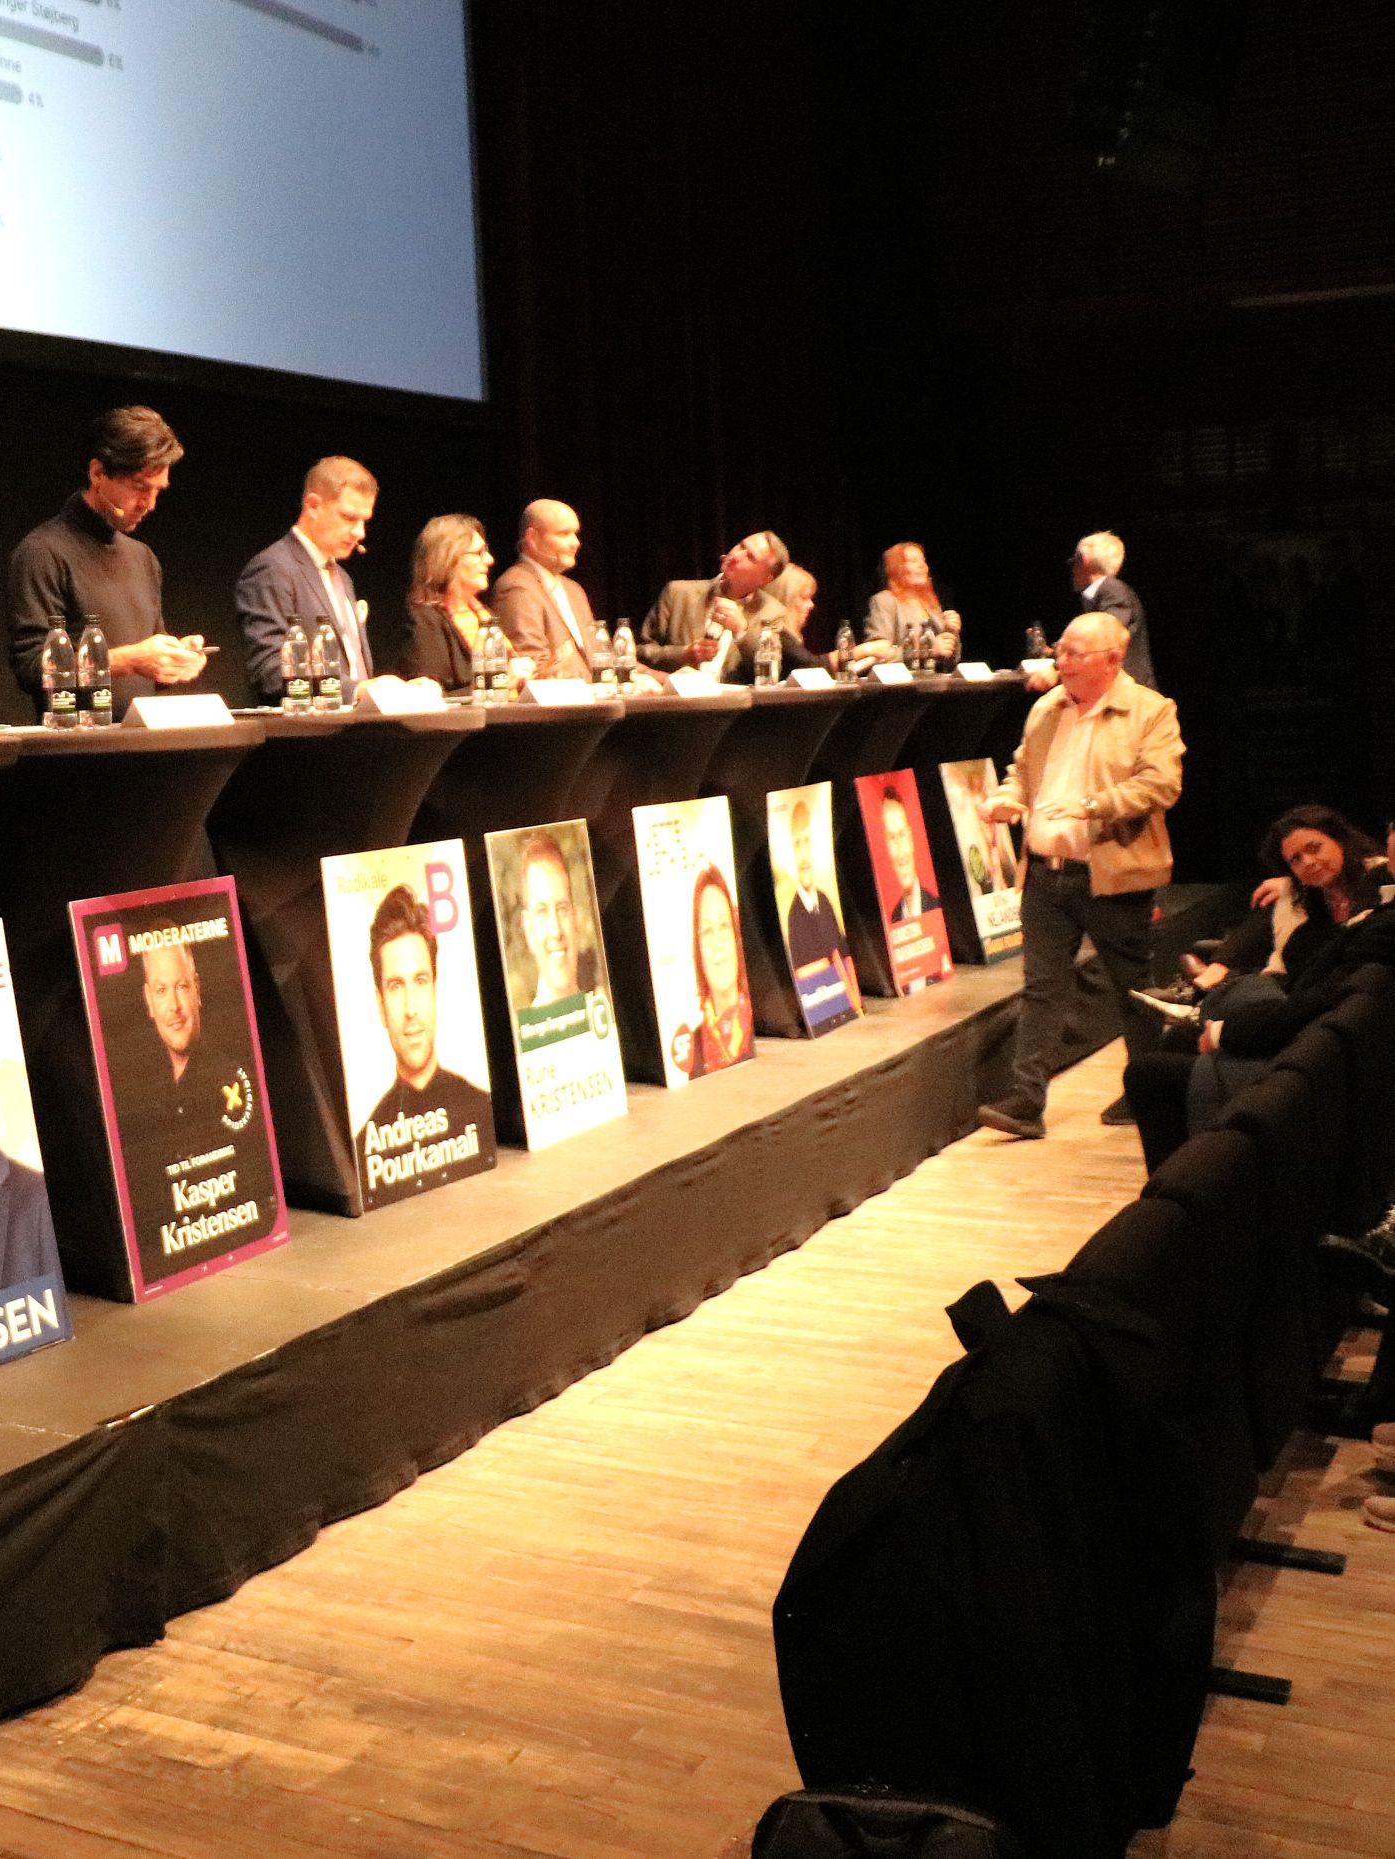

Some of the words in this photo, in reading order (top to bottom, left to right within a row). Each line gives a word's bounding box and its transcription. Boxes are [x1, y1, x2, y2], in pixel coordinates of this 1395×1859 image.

[32, 0, 80, 32] Støjberg
[336, 869, 389, 895] Radikale
[424, 861, 460, 934] B
[98, 933, 123, 965] M
[127, 917, 229, 954] MODERATERNE
[673, 1032, 691, 1062] SF
[529, 1070, 615, 1119] KRISTENSEN
[364, 1107, 449, 1155] Andreas
[366, 1123, 480, 1189] Pourkamali
[171, 1169, 237, 1213] Kasper
[160, 1200, 259, 1255] Kristensen
